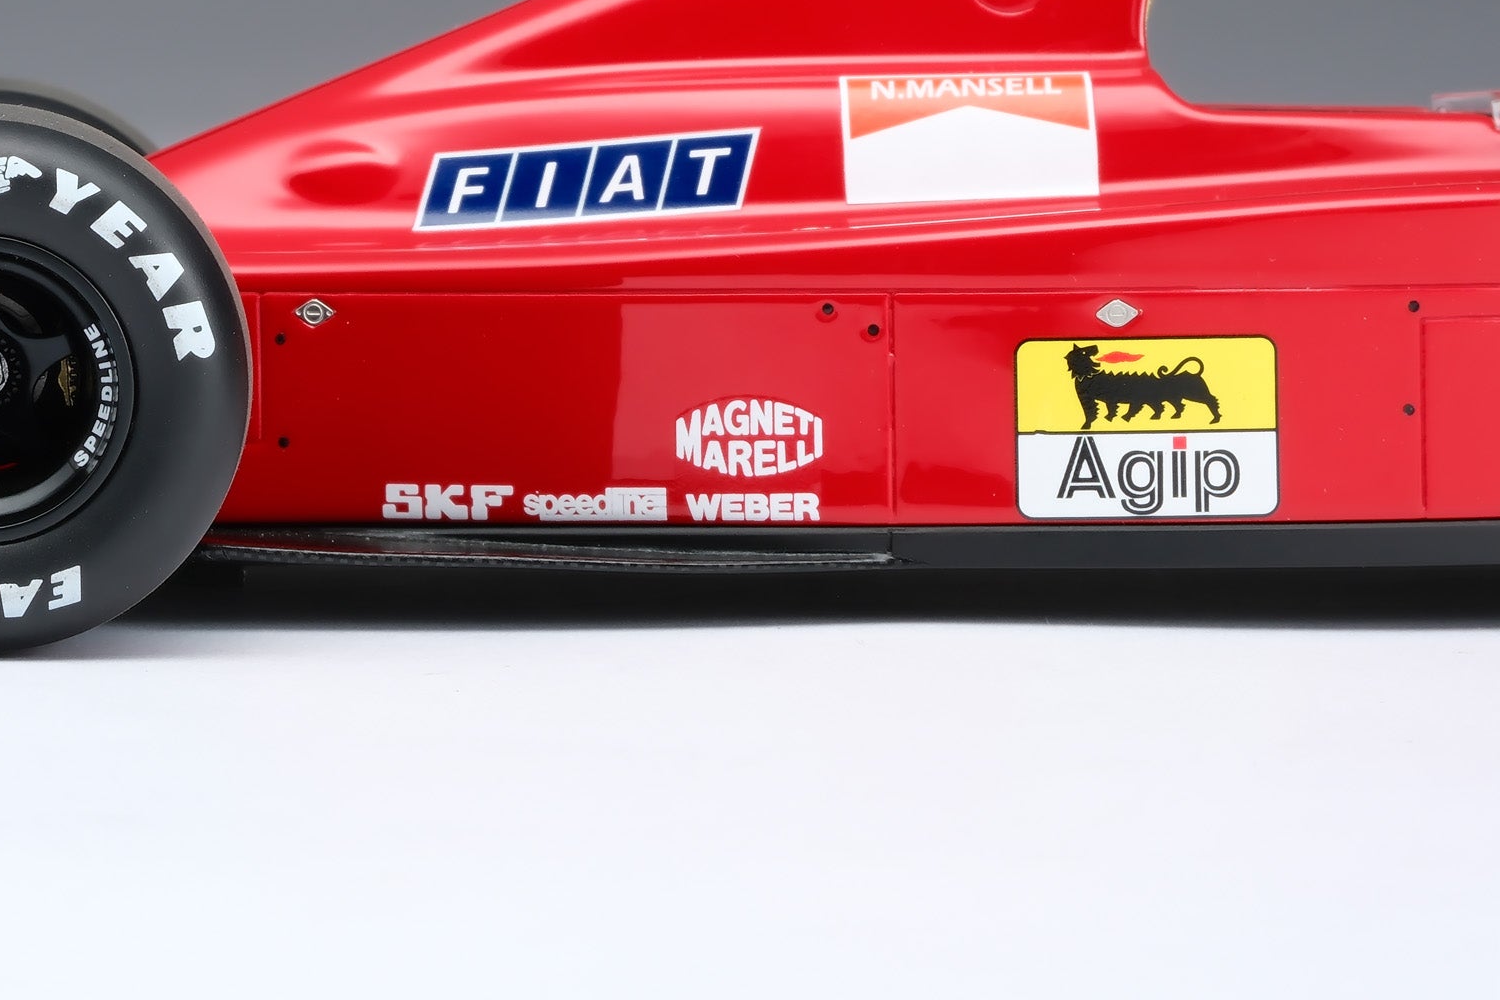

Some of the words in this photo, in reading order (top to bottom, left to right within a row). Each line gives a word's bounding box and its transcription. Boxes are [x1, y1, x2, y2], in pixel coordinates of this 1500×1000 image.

[871, 76, 1062, 100] N.MANSELL
[447, 147, 731, 214] FIAT
[73, 323, 113, 467] SPEEDLINE
[676, 399, 823, 452] MAGNETI
[1056, 436, 1241, 515] Agip
[382, 484, 514, 521] SKF
[686, 493, 821, 521] WEBER
